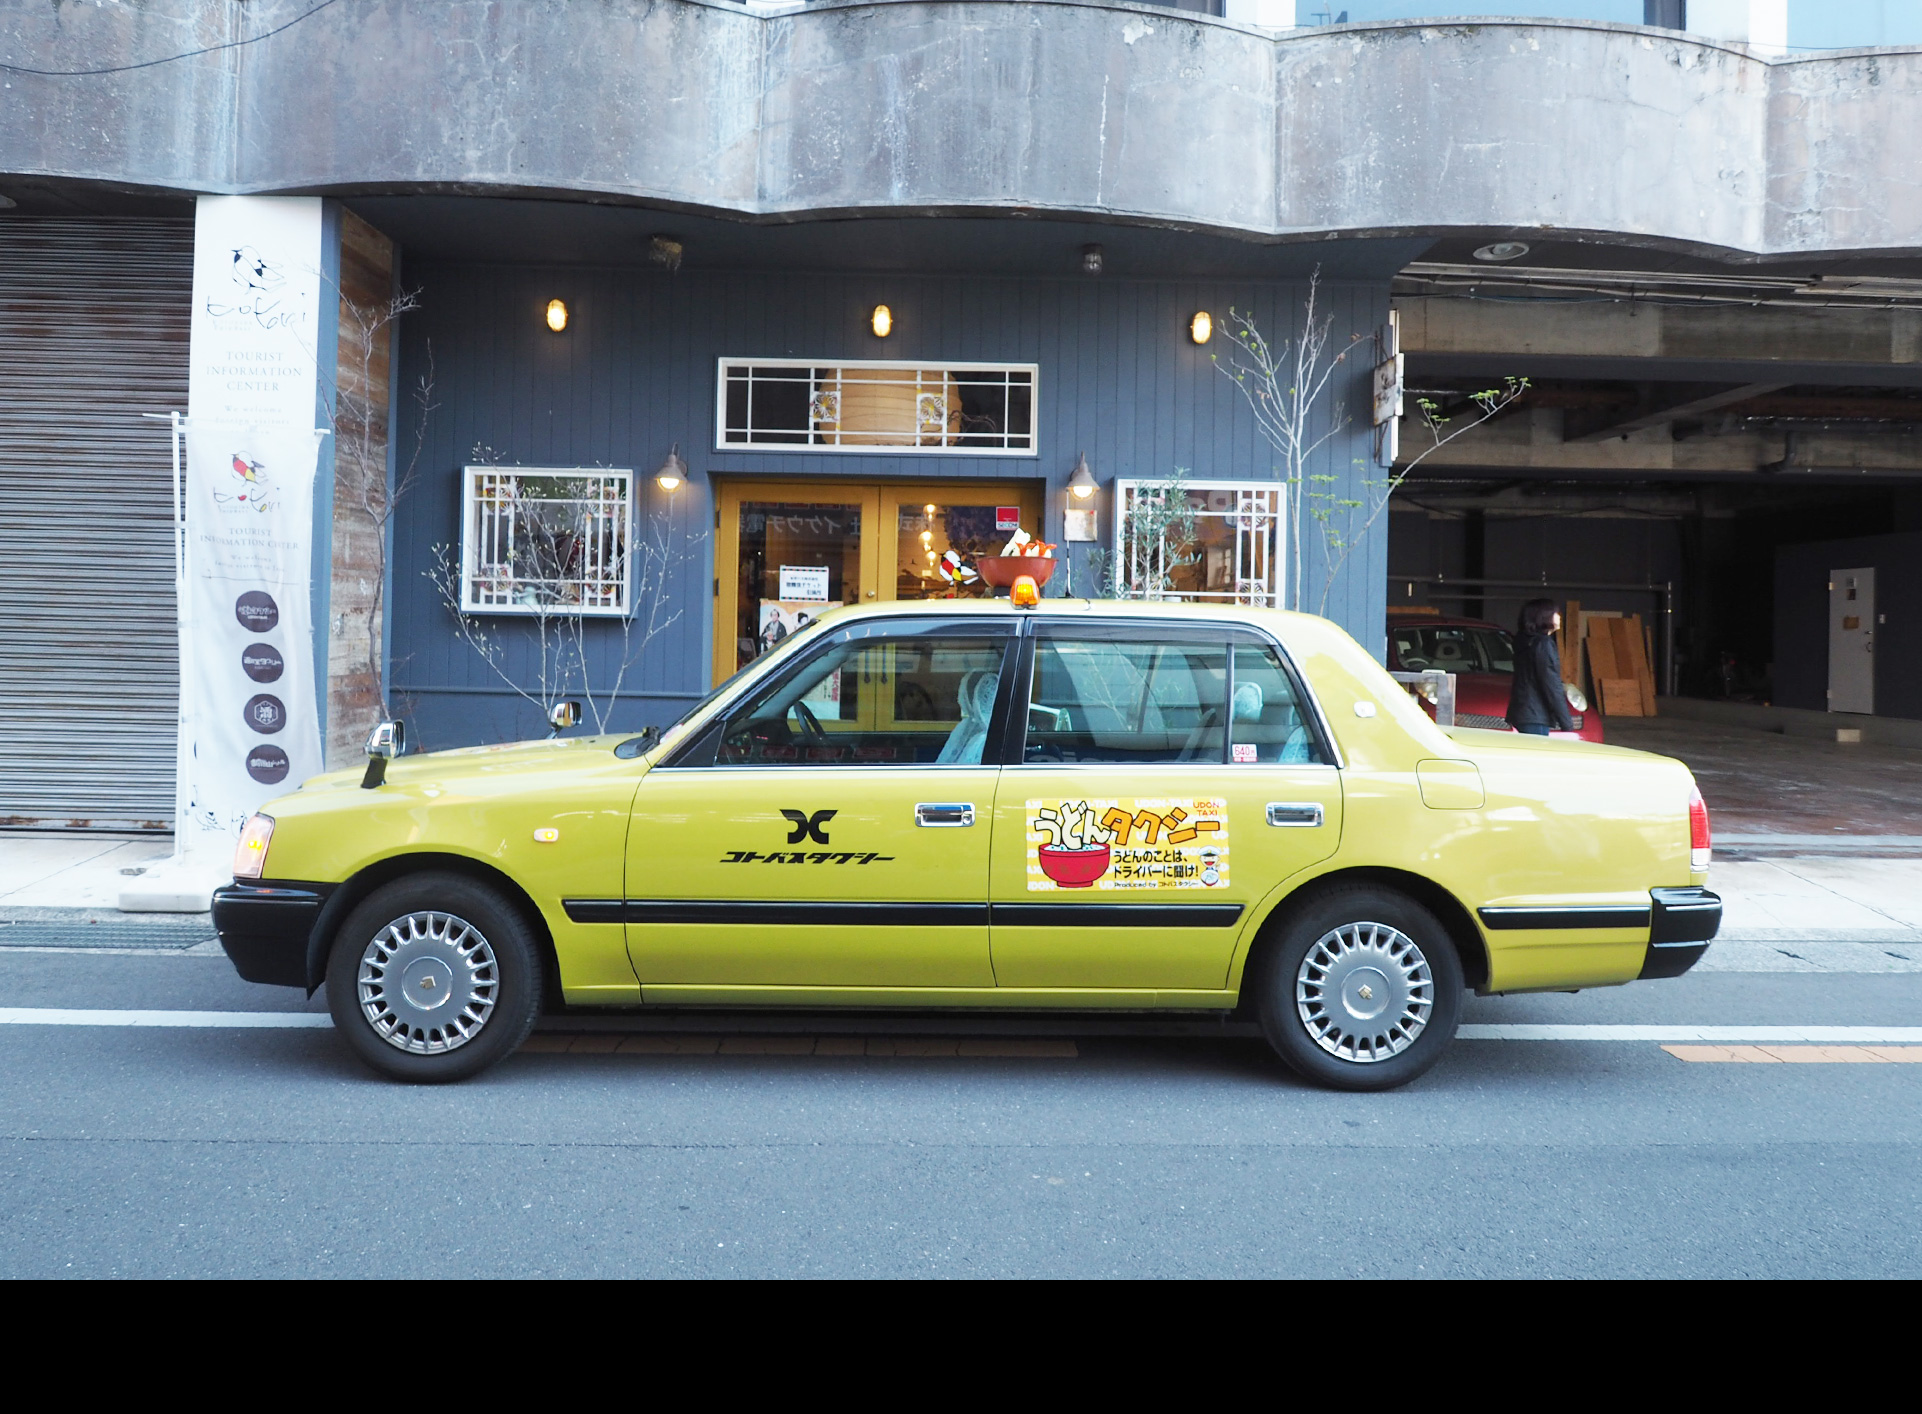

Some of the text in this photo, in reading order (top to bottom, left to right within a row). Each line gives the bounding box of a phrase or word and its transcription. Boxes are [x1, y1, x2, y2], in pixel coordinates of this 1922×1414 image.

[226, 351, 284, 362] TOURIST
[206, 366, 303, 377] INFORMATION
[226, 381, 280, 392] CENTER
[228, 527, 272, 537] TOURIST
[1193, 801, 1220, 809] UDON
[1196, 809, 1218, 817] TAXI
[1033, 799, 1221, 851] うどんタクシー
[719, 851, 896, 865] コトバスタクシー
[1114, 850, 1188, 863] うどんのことは、
